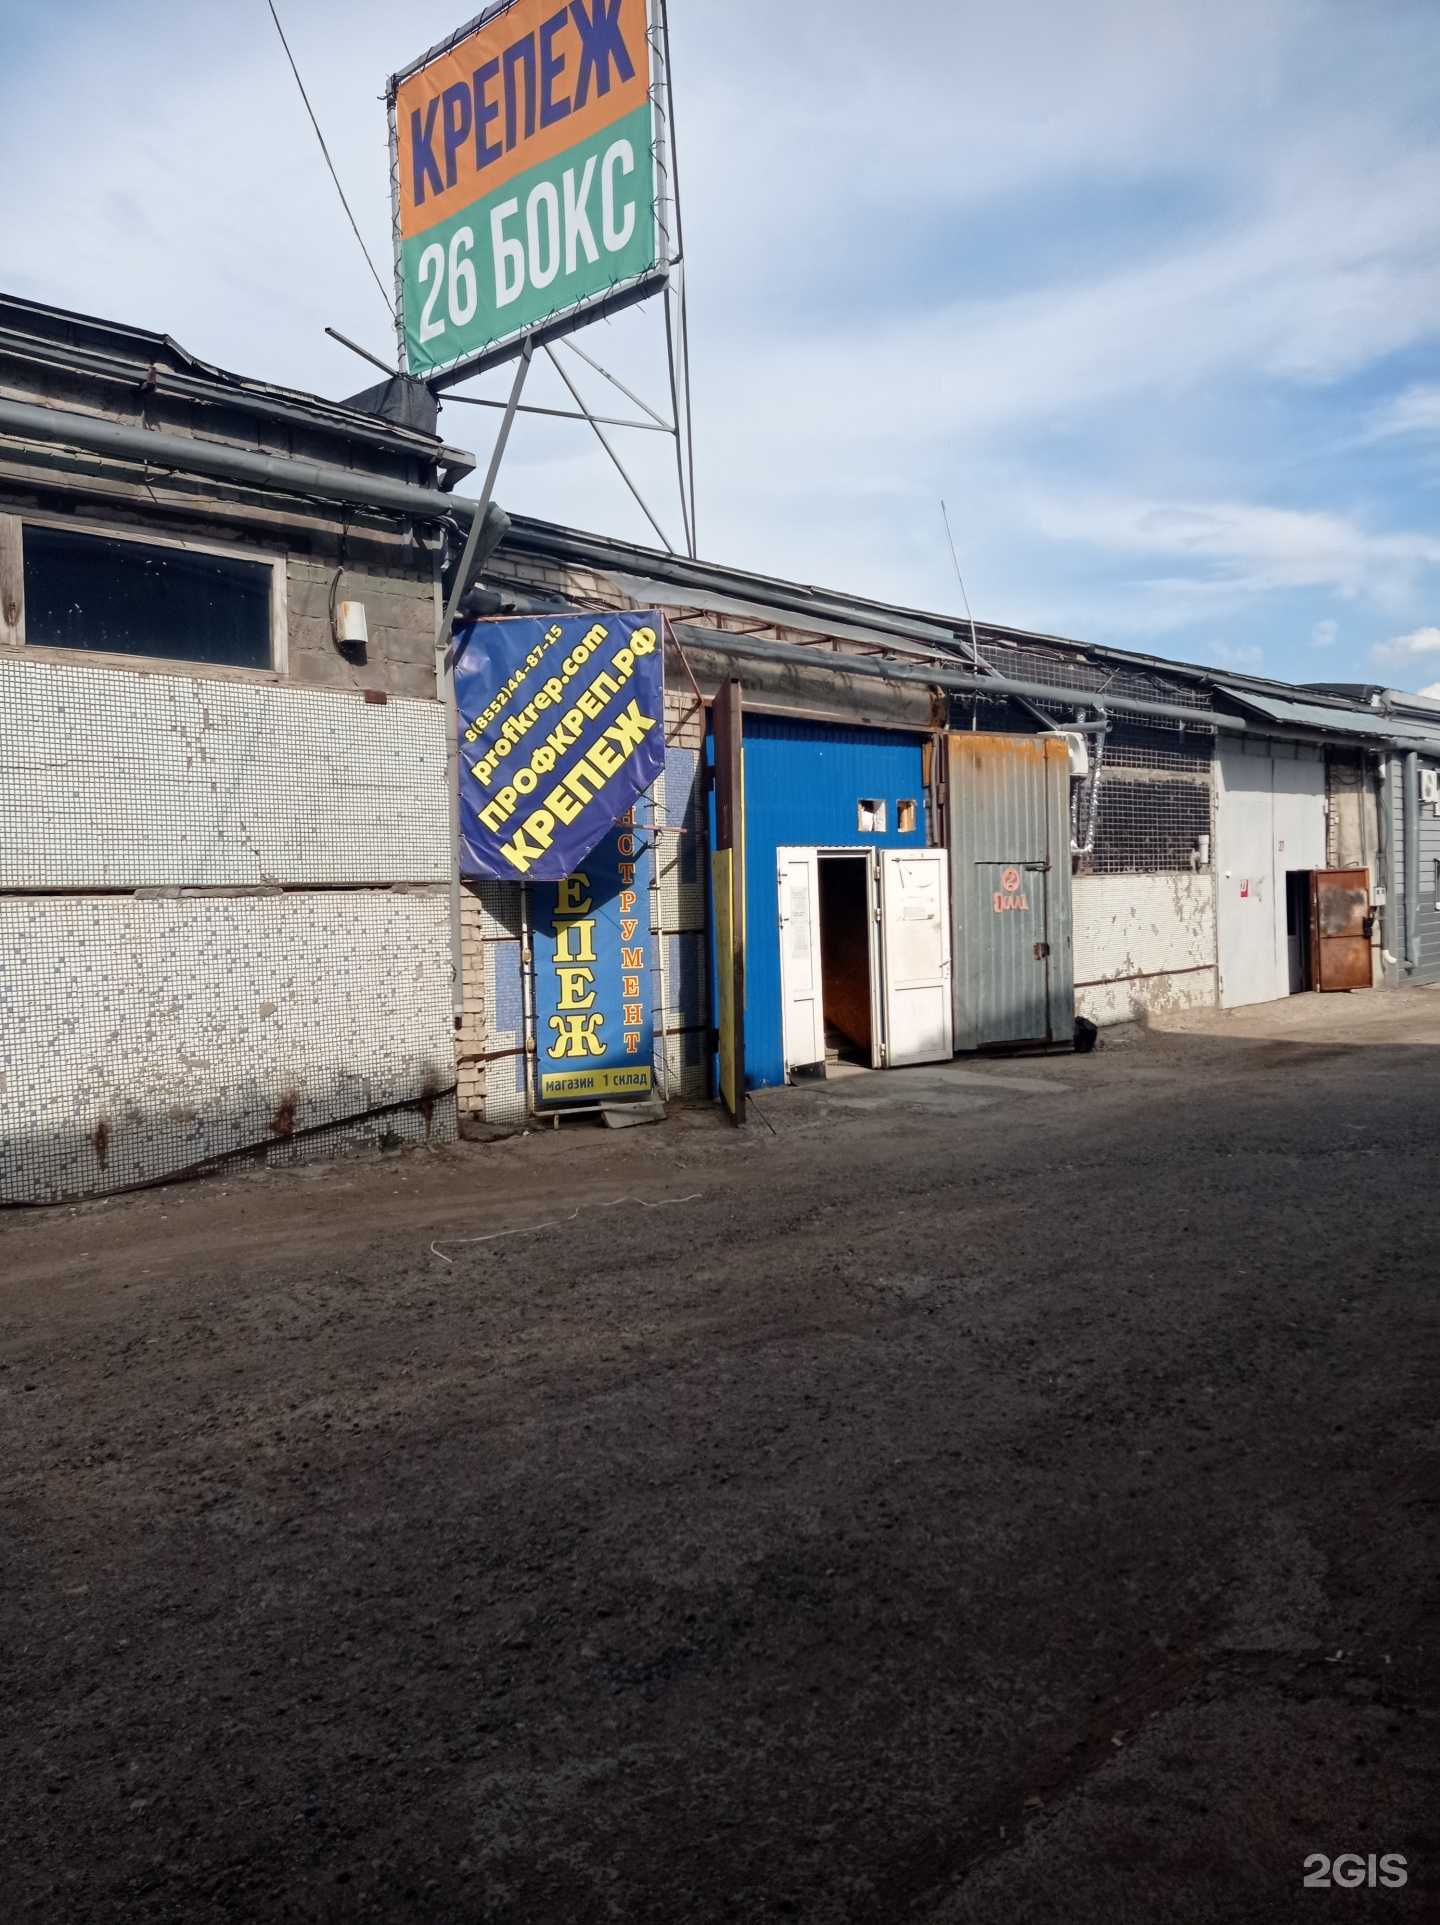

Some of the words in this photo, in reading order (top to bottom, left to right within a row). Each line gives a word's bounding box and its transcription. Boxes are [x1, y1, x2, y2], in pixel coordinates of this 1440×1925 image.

[410, 0, 636, 207] КРЕПЕЖ
[418, 226, 478, 343] 26
[490, 139, 636, 309] БОКС
[464, 624, 563, 743] 8(8552)44-87-15
[471, 623, 609, 786] profkrep.com
[478, 626, 656, 832] ПРОФКРЕП.РФ
[500, 699, 656, 873] КРЕПЕЖ
[548, 872, 607, 1058] ЕПЕЖ
[617, 805, 643, 1054] НСТРУМЕНТ
[545, 1076, 594, 1093] магазин
[602, 1072, 609, 1087] 1
[613, 1071, 648, 1087] склад
